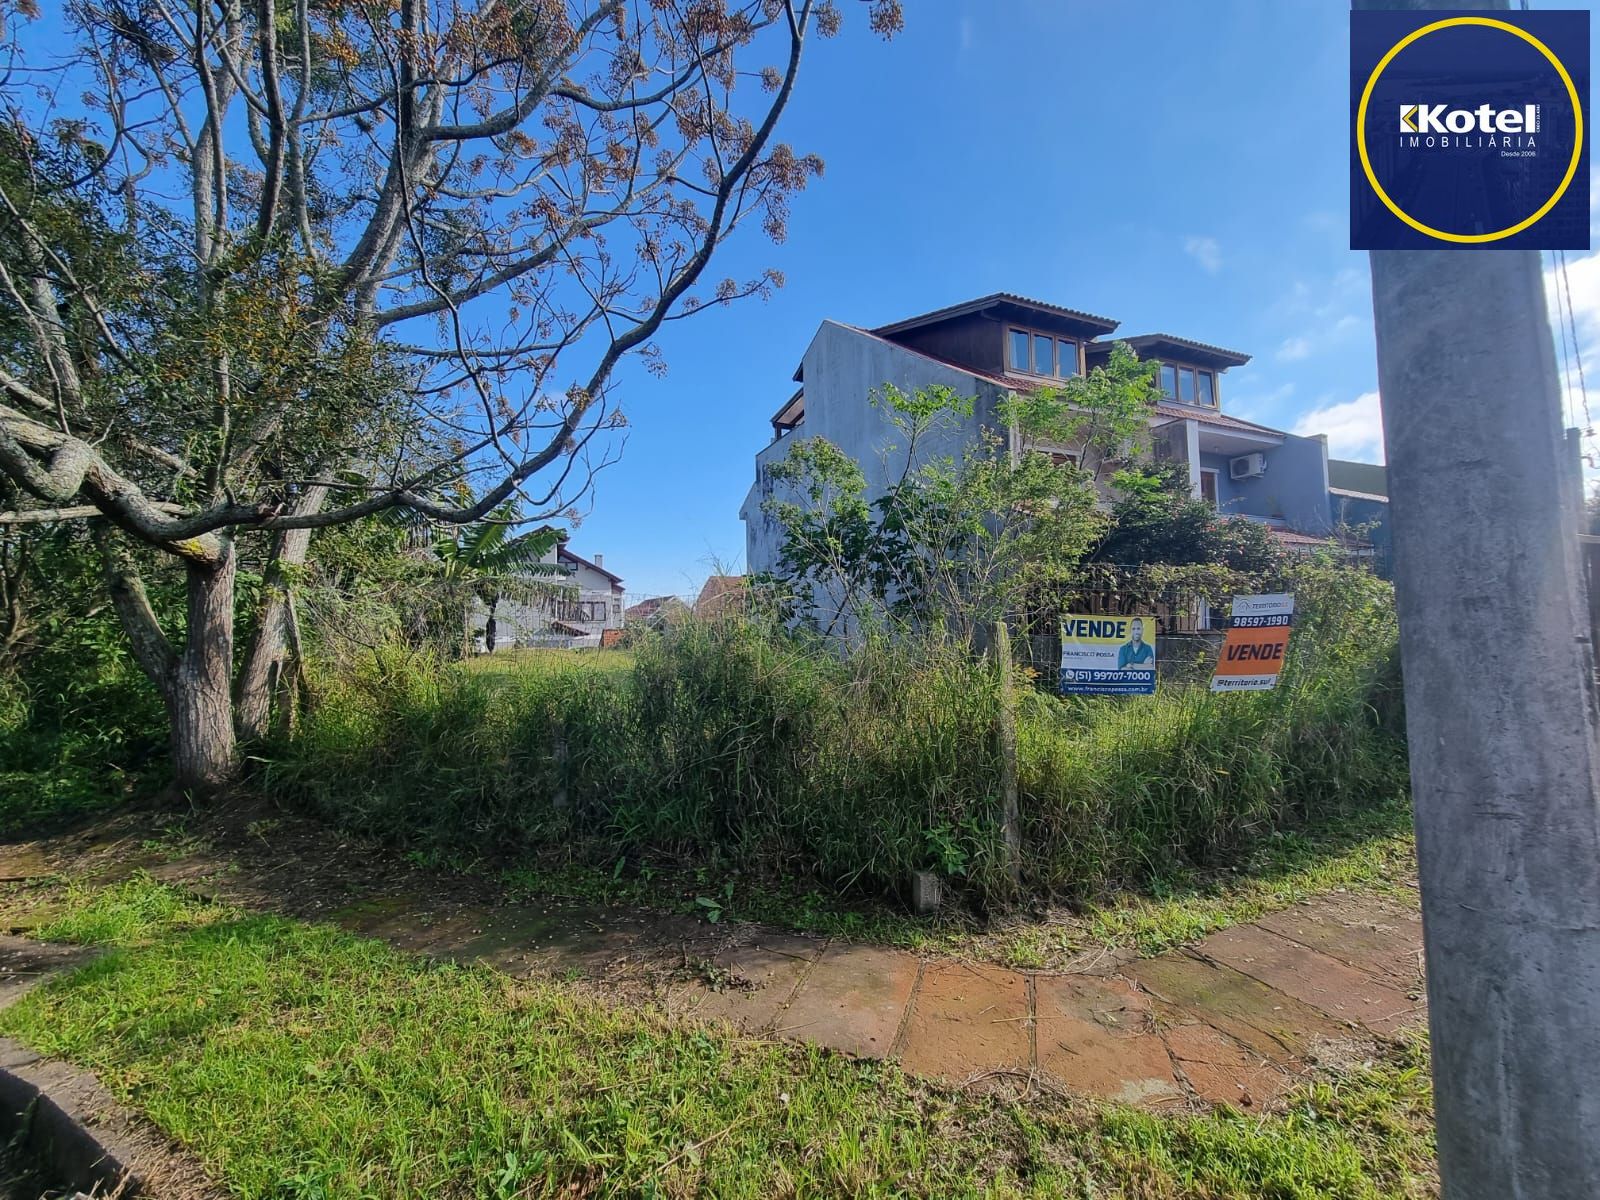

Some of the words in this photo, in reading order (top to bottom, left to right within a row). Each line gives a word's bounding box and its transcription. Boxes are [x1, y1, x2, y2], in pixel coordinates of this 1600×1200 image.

[1233, 615, 1289, 627] 98597-1990
[1064, 619, 1127, 639] VENDE
[1227, 642, 1284, 661] VENDE
[1075, 670, 1092, 682] (51)
[1094, 671, 1151, 681] 99707-7000
